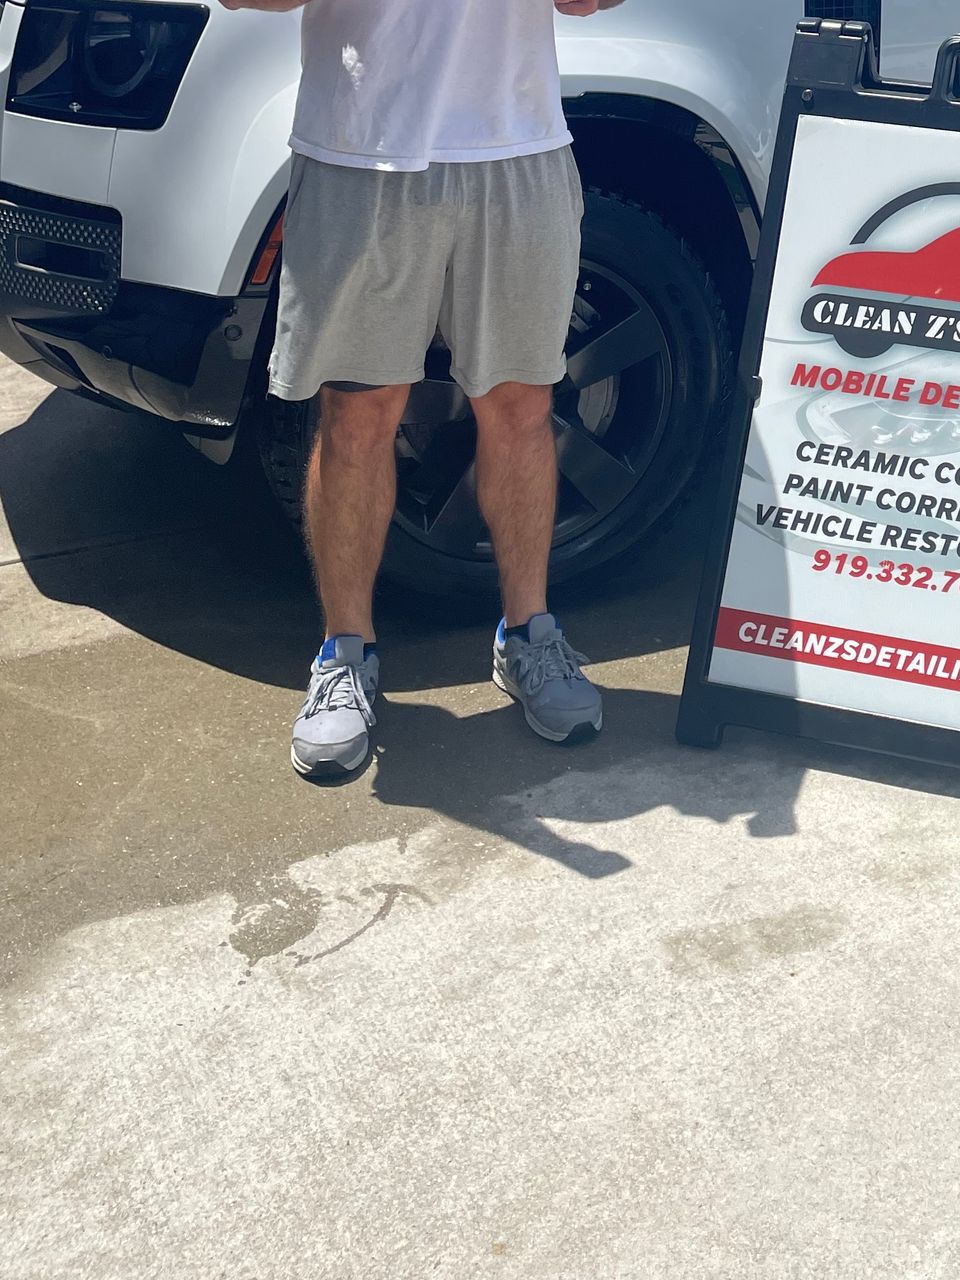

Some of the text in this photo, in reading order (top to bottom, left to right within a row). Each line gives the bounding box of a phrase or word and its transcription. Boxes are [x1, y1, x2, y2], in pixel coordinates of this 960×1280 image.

[813, 300, 917, 335] CLEAN
[790, 363, 916, 401] MOBILE
[796, 441, 930, 480] CERAMIC
[783, 473, 873, 506] PAINT
[756, 503, 877, 544] VEHICLE
